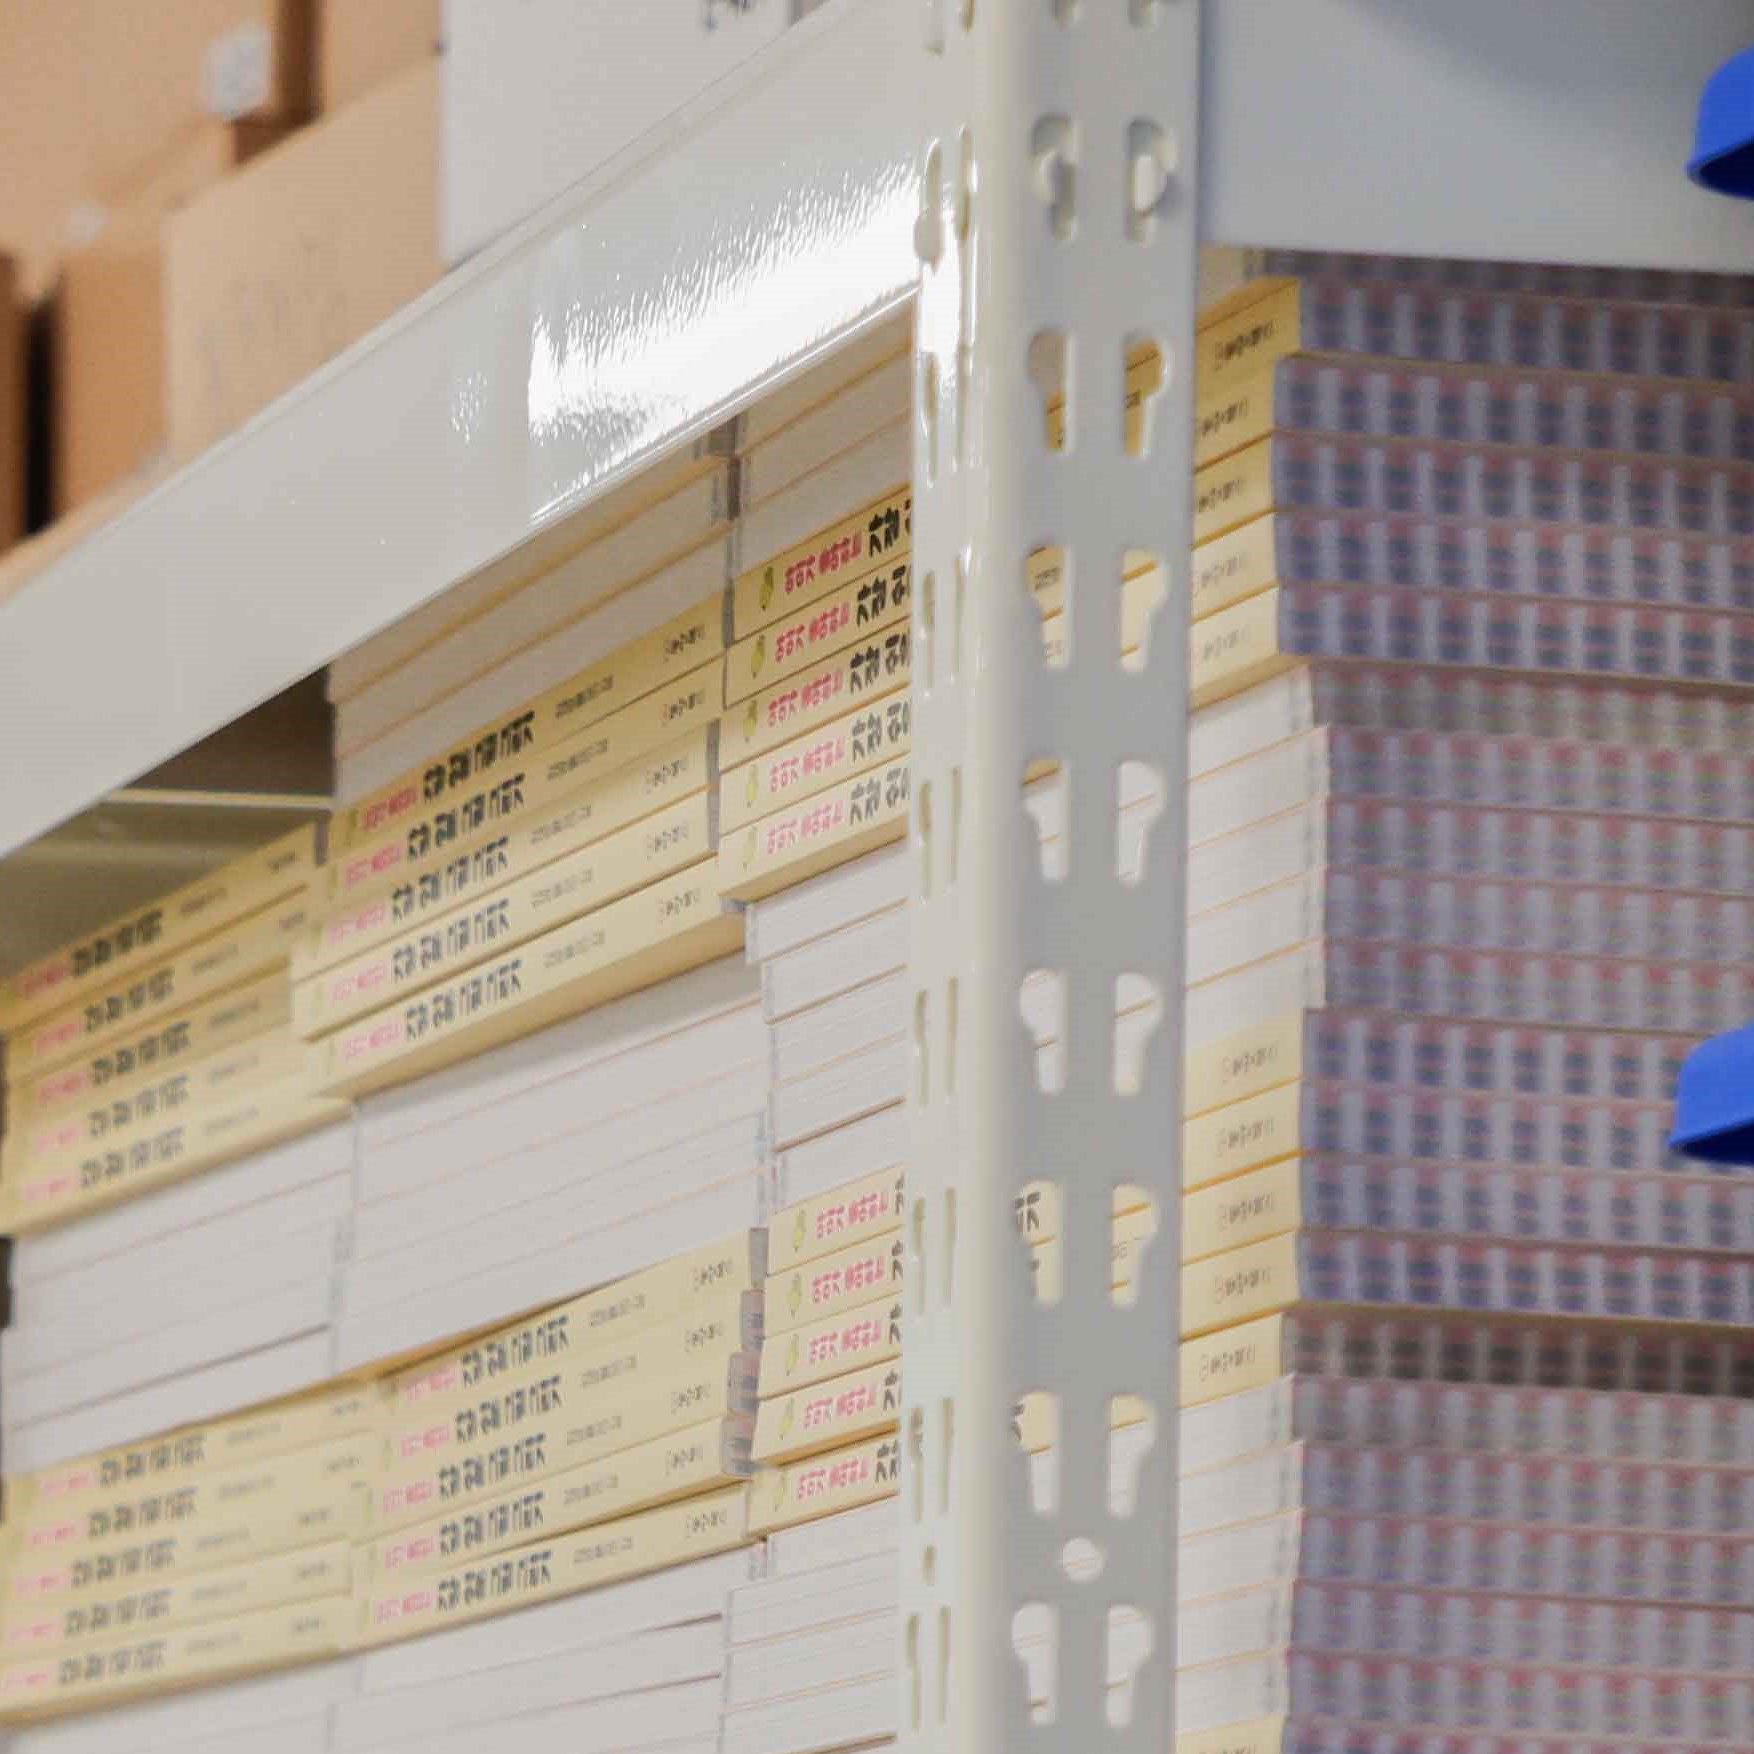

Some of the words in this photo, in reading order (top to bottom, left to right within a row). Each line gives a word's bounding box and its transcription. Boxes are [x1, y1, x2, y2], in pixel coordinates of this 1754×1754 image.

[868, 507, 900, 557] 가장
[857, 576, 886, 626] 가장
[850, 646, 879, 694] 가장
[852, 712, 882, 762] 가장
[850, 778, 881, 825] 가장
